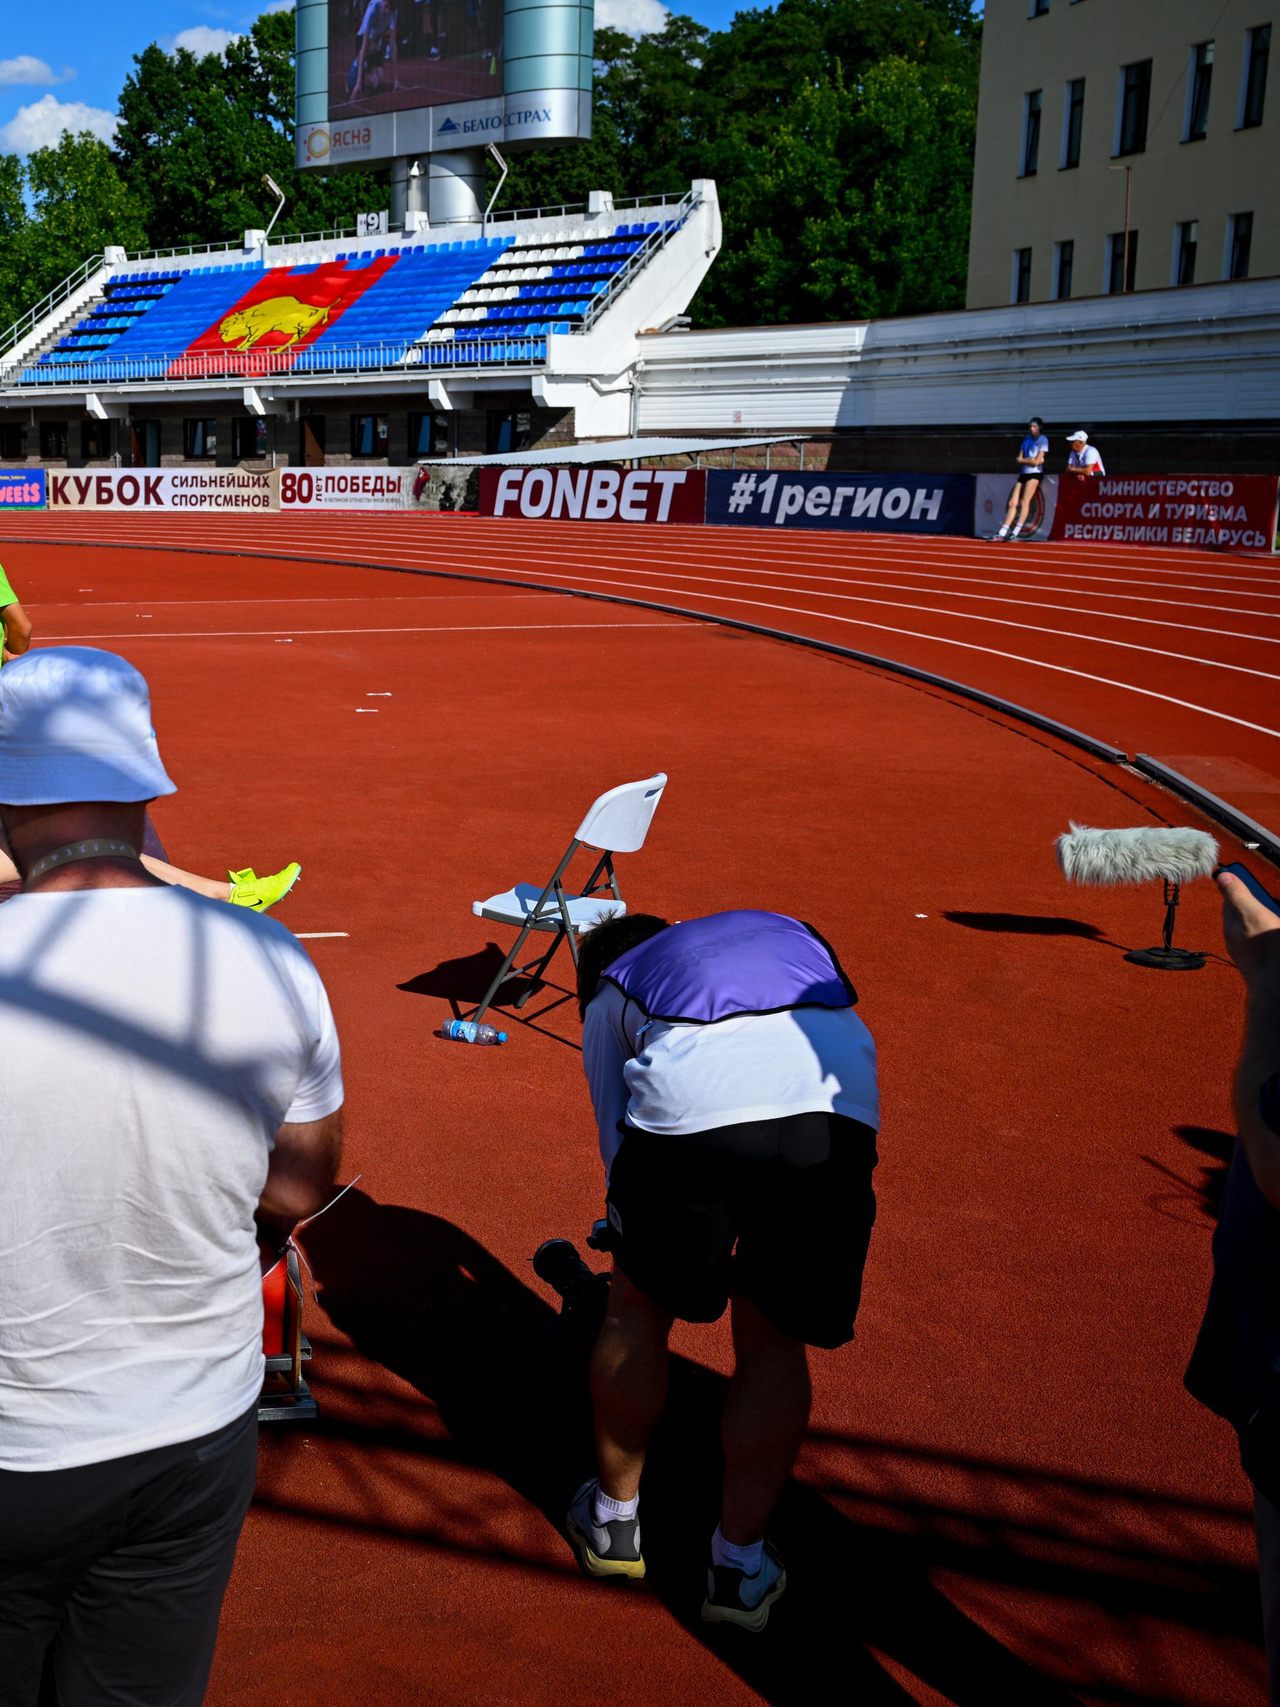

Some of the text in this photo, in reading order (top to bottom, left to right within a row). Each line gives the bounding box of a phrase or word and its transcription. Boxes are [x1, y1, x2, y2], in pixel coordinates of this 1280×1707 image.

[367, 213, 379, 230] 9
[52, 475, 164, 506] КУБОК
[171, 473, 270, 488] СИЛЬНЕЙШИХ
[281, 473, 313, 504] 80
[315, 475, 323, 502] лет
[324, 475, 402, 497] ПОБЕДЫ
[1099, 480, 1234, 498] МИНИСТЕРСТВО
[171, 494, 270, 507] СПОРТСМЕНОВ
[493, 469, 687, 522] FONBET
[728, 474, 944, 524] #1регион
[1081, 503, 1248, 522] СПОРТА И ТУРИЗМА
[1065, 524, 1266, 548] РЕСПУБЛИКИ БЕЛАРУСЬ
